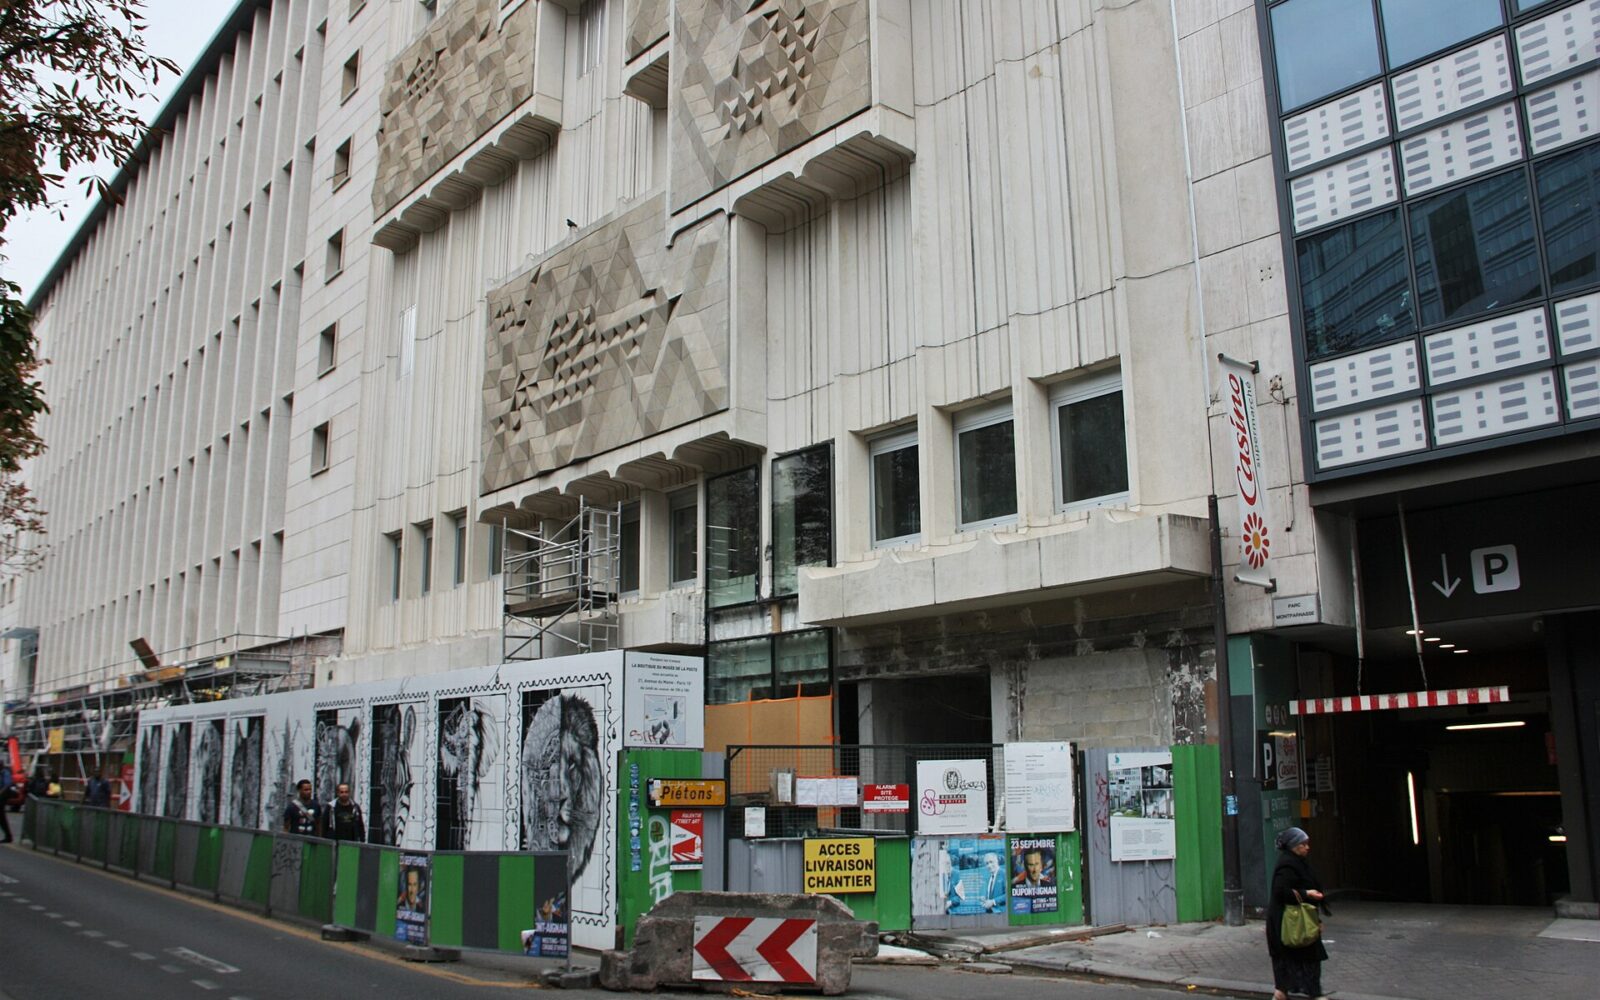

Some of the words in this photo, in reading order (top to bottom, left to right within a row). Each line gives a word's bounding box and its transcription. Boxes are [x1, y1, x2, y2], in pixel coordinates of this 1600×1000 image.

[1245, 381, 1261, 469] supermarché
[1228, 373, 1257, 506] Casino
[1483, 552, 1508, 586] P
[1276, 611, 1315, 619] MONTPARNASSE
[1263, 742, 1273, 779] P
[660, 785, 712, 800] Piétons
[818, 843, 860, 856] ACCES
[1010, 840, 1020, 849] 23
[1020, 839, 1055, 848] SEPTEMBRE
[805, 859, 873, 872] LIVRAISON
[807, 875, 872, 888] CHANTIER
